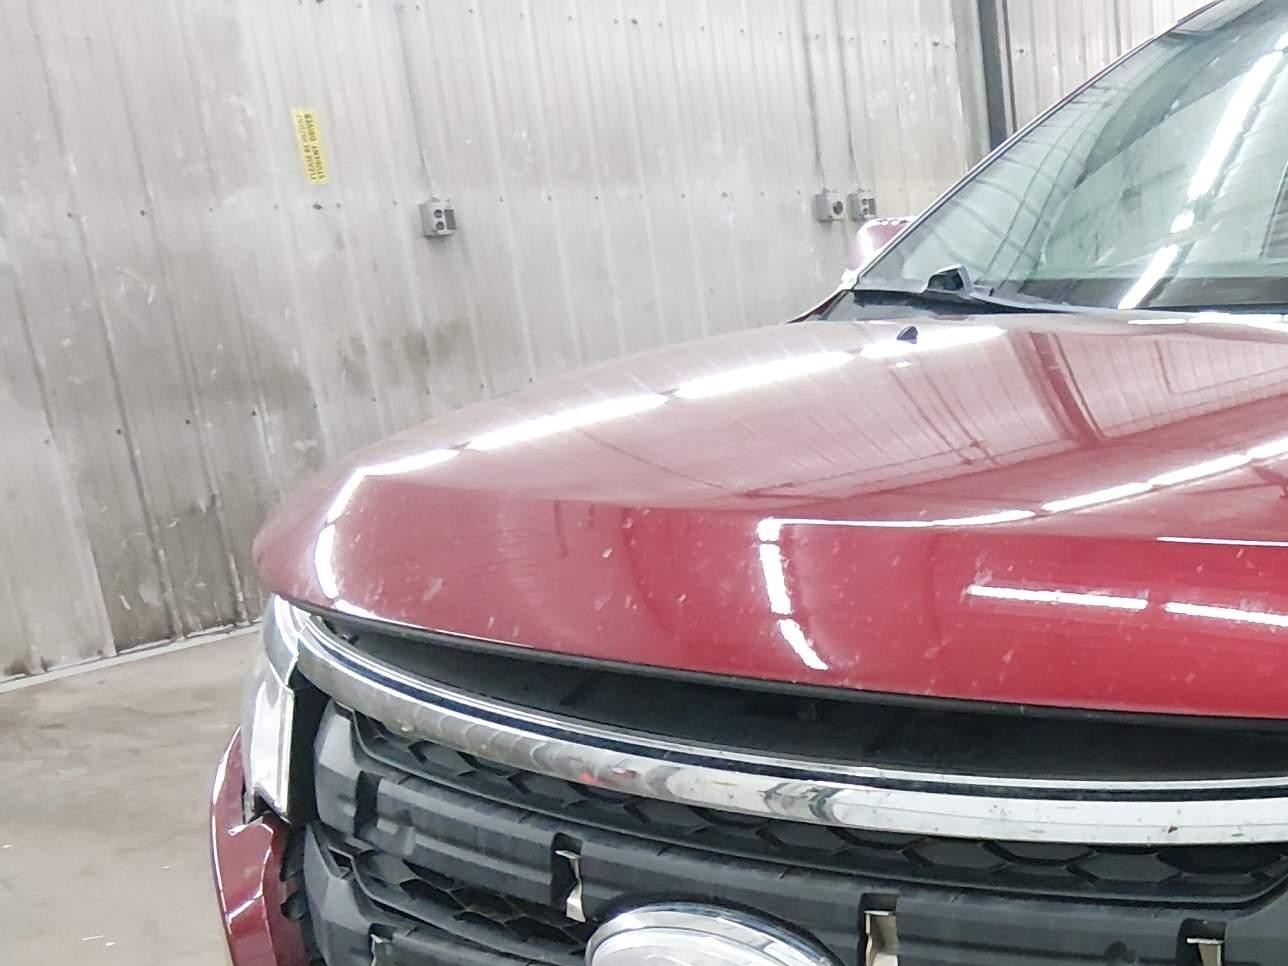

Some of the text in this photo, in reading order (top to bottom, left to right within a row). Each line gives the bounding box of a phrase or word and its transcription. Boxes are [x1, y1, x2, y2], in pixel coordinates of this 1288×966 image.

[303, 113, 326, 180] STUDENT DRIVER
[304, 154, 317, 180] PLEASE
